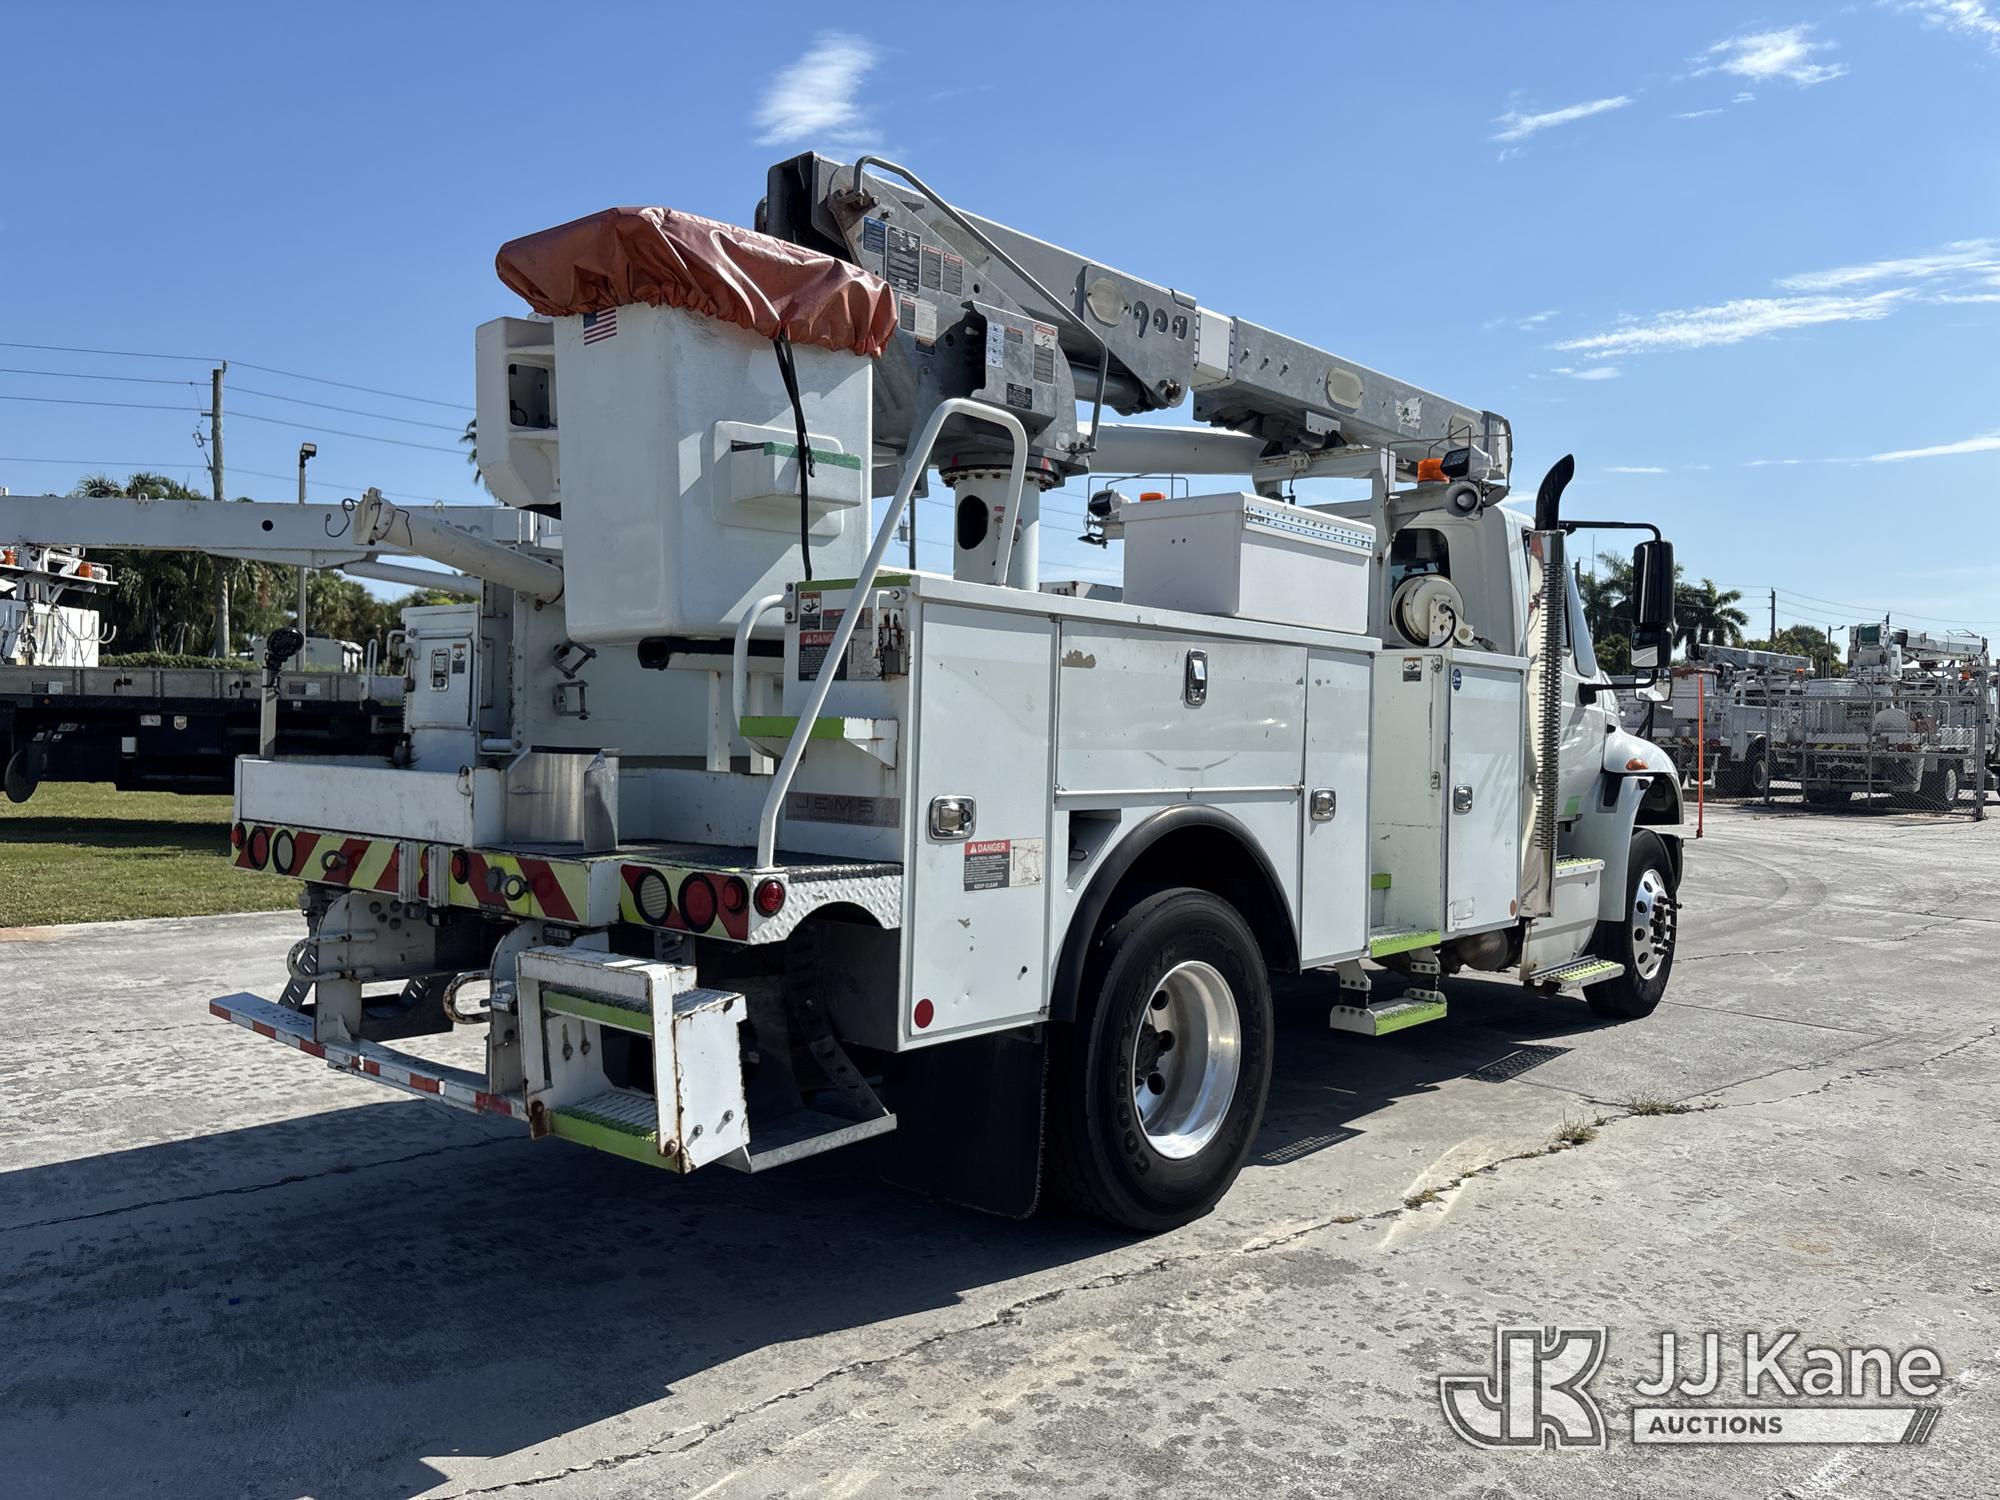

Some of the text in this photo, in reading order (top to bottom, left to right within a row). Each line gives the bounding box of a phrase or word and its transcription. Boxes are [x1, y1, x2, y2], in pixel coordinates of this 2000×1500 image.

[813, 633, 834, 644] DANG
[795, 795, 873, 814] JEMS
[977, 842, 1006, 854] DANGER
